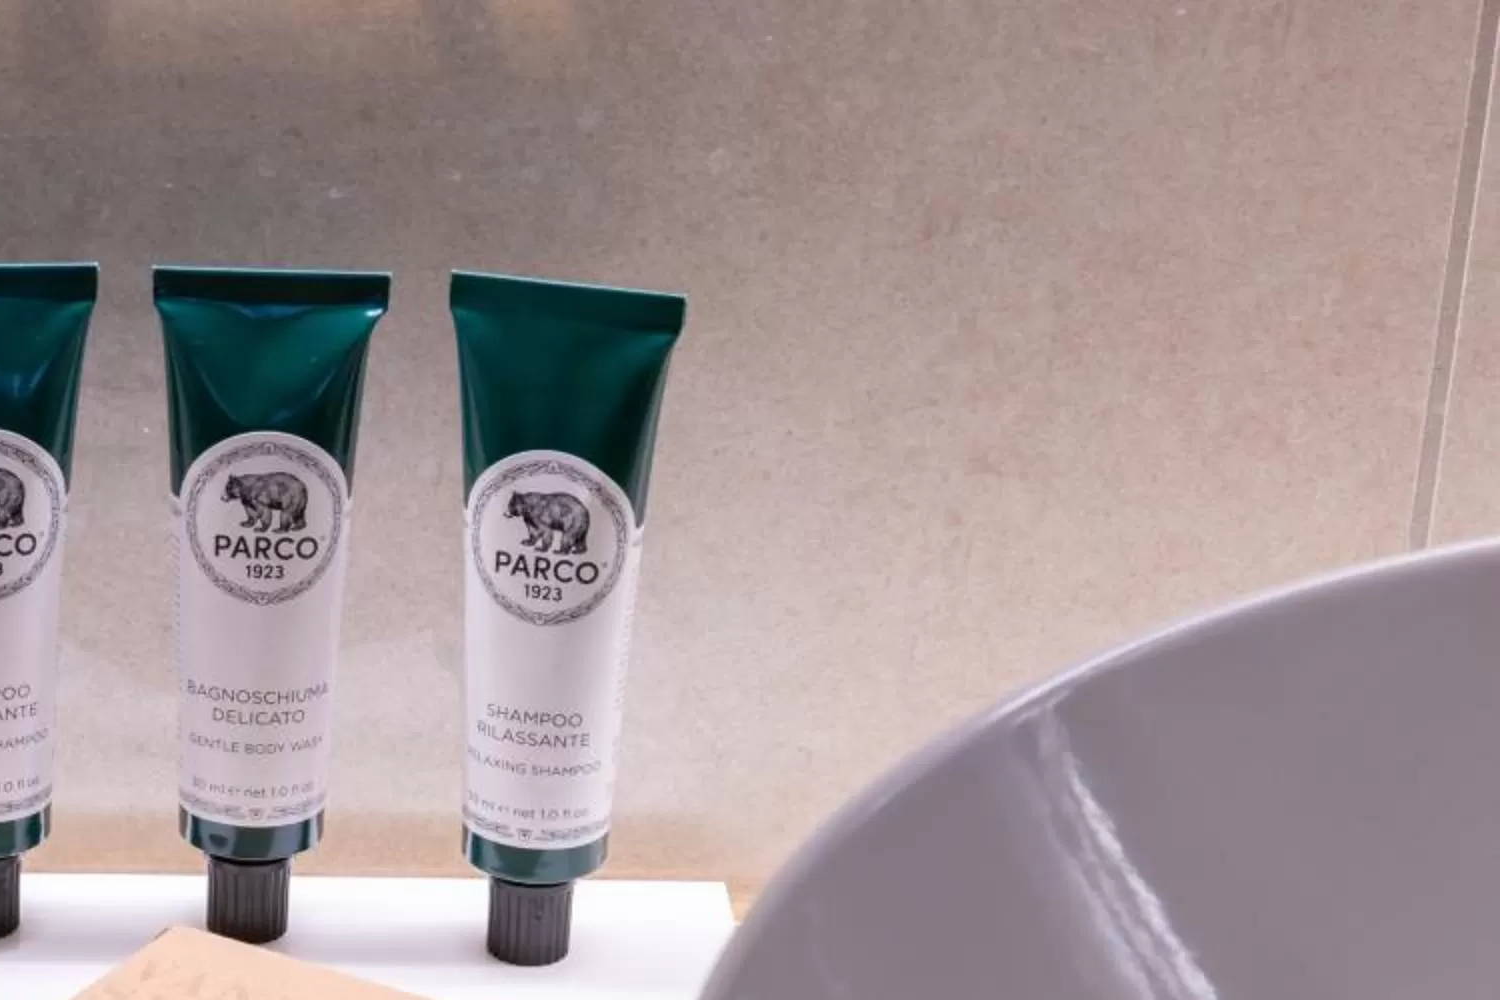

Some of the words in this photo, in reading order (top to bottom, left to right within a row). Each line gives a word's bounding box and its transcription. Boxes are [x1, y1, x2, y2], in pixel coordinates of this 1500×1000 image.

[214, 534, 319, 560] PARCO
[245, 564, 285, 579] 1923
[495, 551, 599, 585] PARCO
[524, 584, 563, 602] 1923
[187, 678, 329, 705] BAGNOSCHIUMA
[212, 707, 305, 726] DELICATO
[486, 703, 583, 729] SHAMPOO
[188, 732, 241, 753] GENTLE
[244, 741, 285, 755] BODY
[477, 719, 590, 749] RILASSANTE
